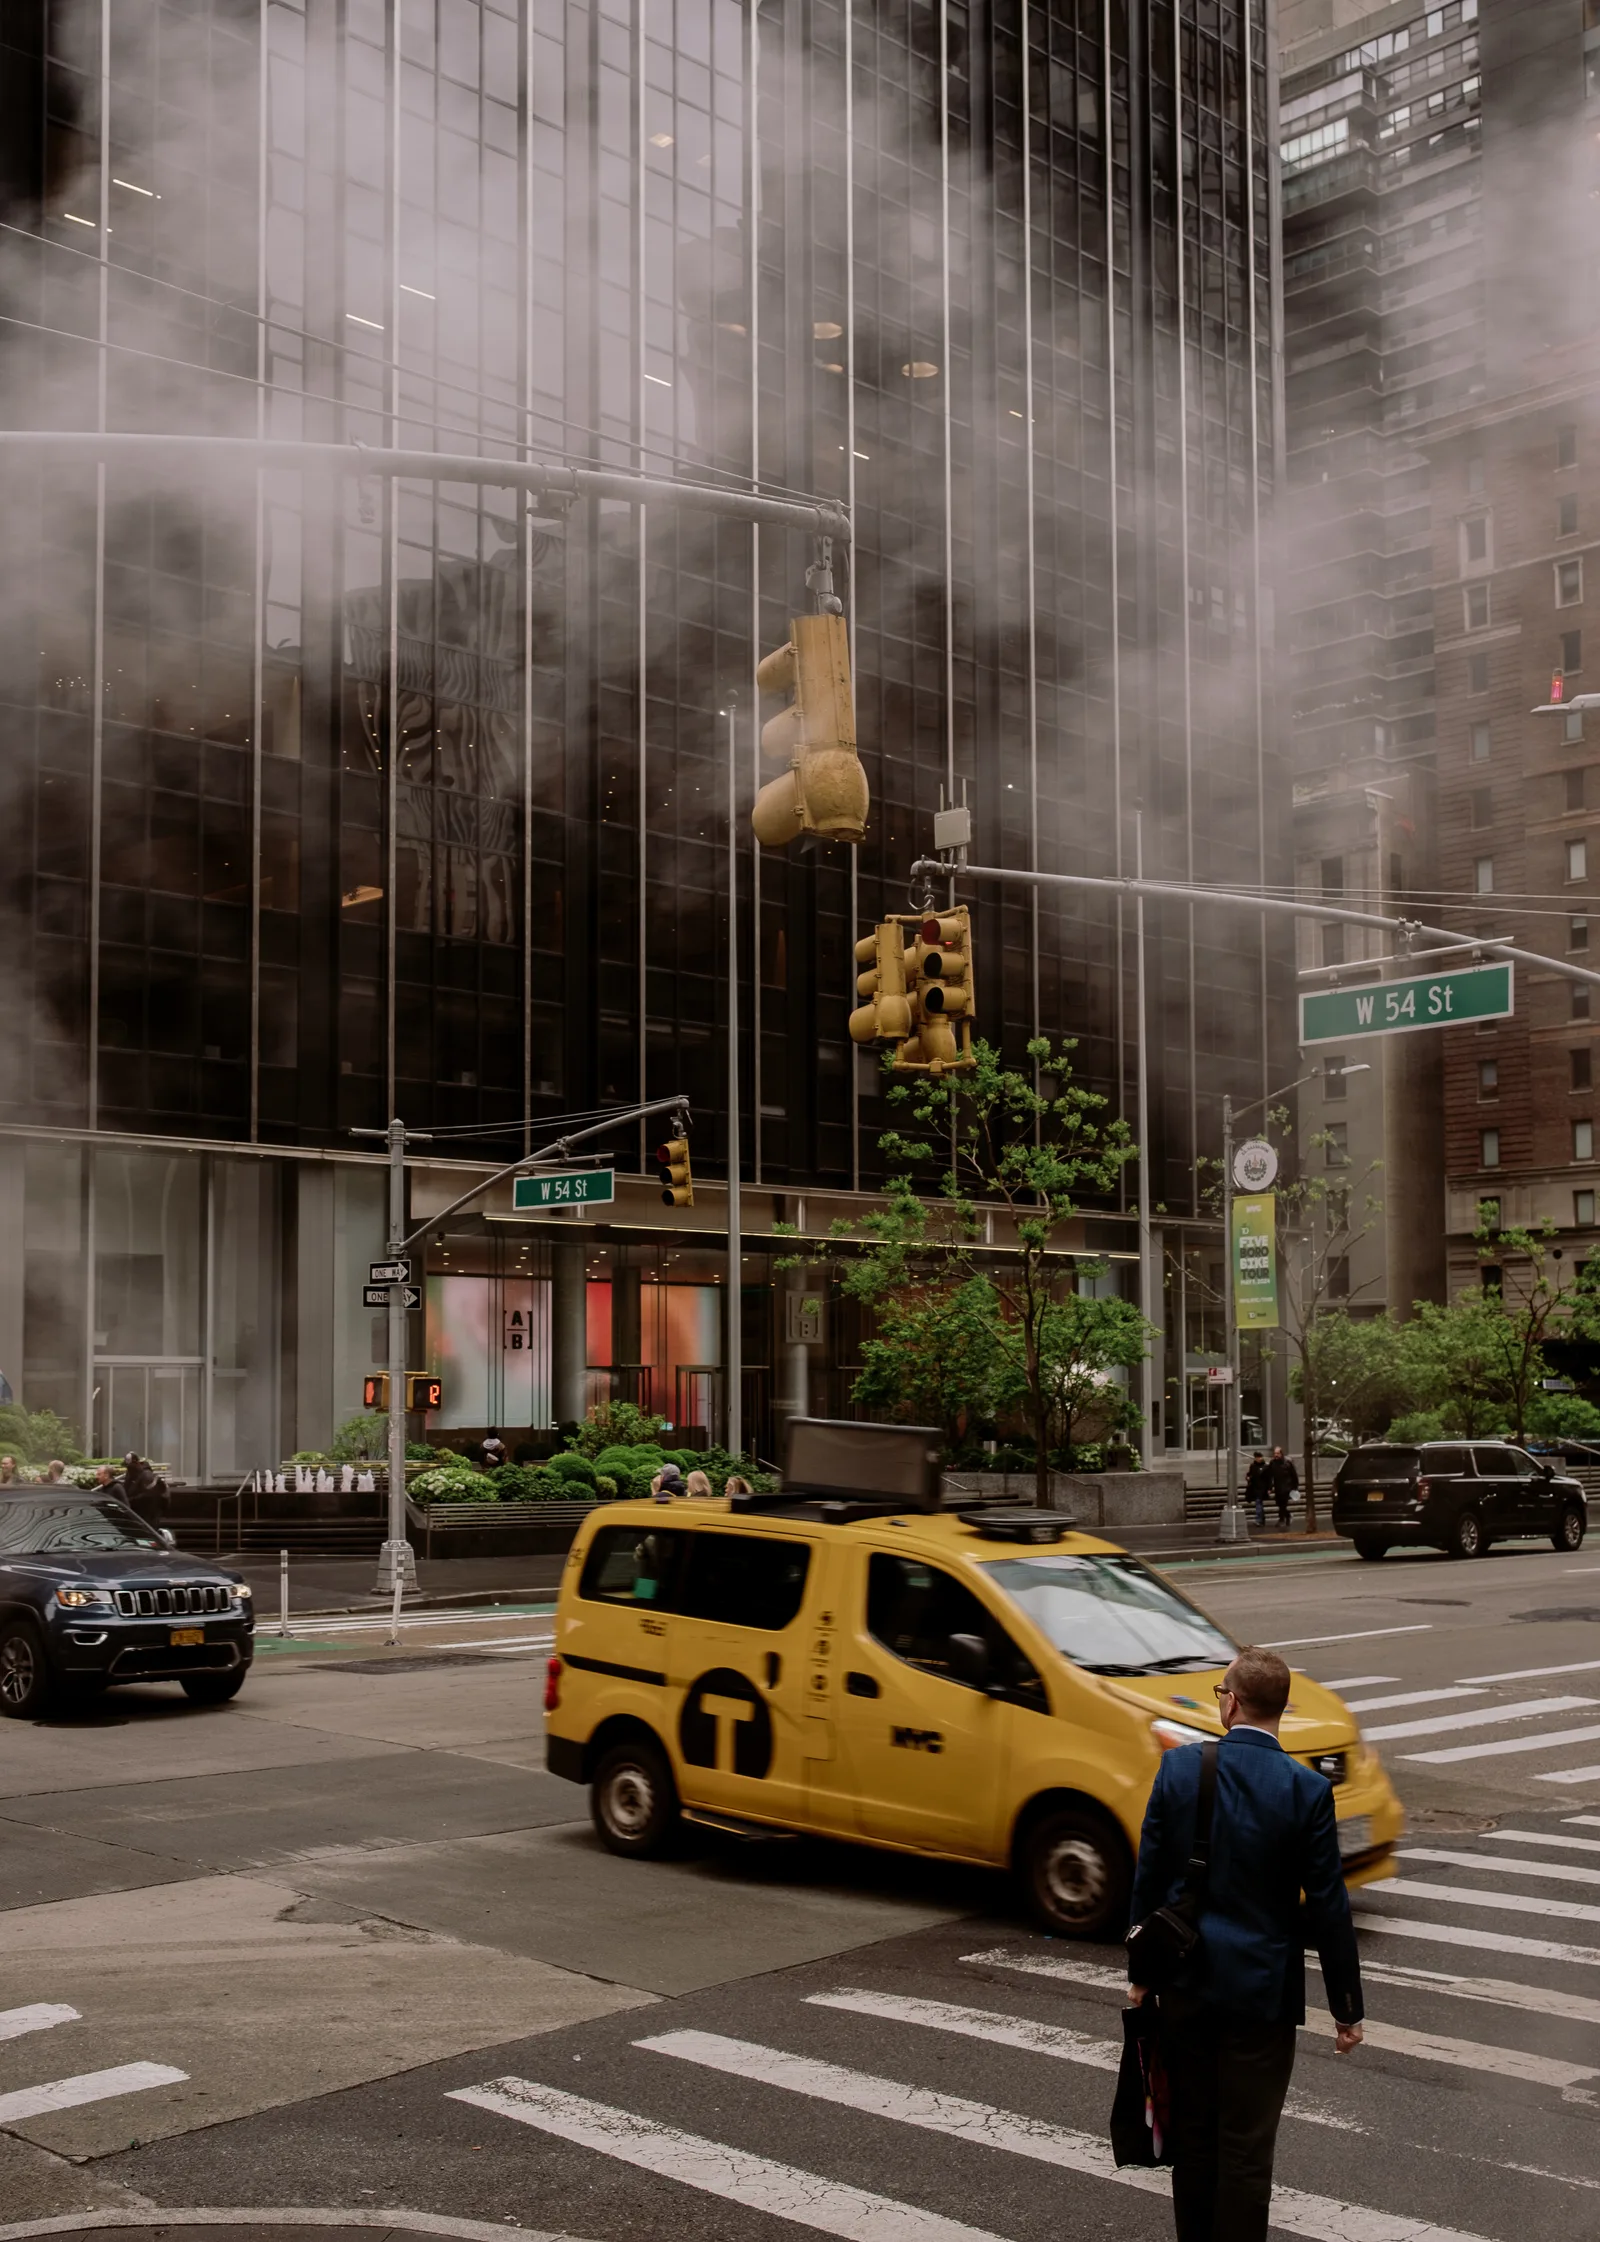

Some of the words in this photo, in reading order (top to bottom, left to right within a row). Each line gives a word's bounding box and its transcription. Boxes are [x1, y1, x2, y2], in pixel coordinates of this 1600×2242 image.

[1356, 995, 1374, 1025] W
[1385, 989, 1416, 1022] 54
[1427, 984, 1453, 1015] St
[541, 1182, 551, 1200] W
[555, 1180, 570, 1200] 54
[574, 1179, 588, 1198] St
[1239, 1235, 1269, 1248] FIVE
[1240, 1246, 1269, 1258] BORO
[1239, 1257, 1269, 1269] BIKE
[374, 1269, 387, 1278] ONE
[391, 1267, 405, 1277] WAY
[1240, 1268, 1270, 1280] TOUR
[371, 1292, 389, 1302] ONE
[511, 1310, 523, 1326] A
[512, 1334, 523, 1349] B
[701, 1692, 755, 1774] T
[890, 1725, 946, 1755] NYC
